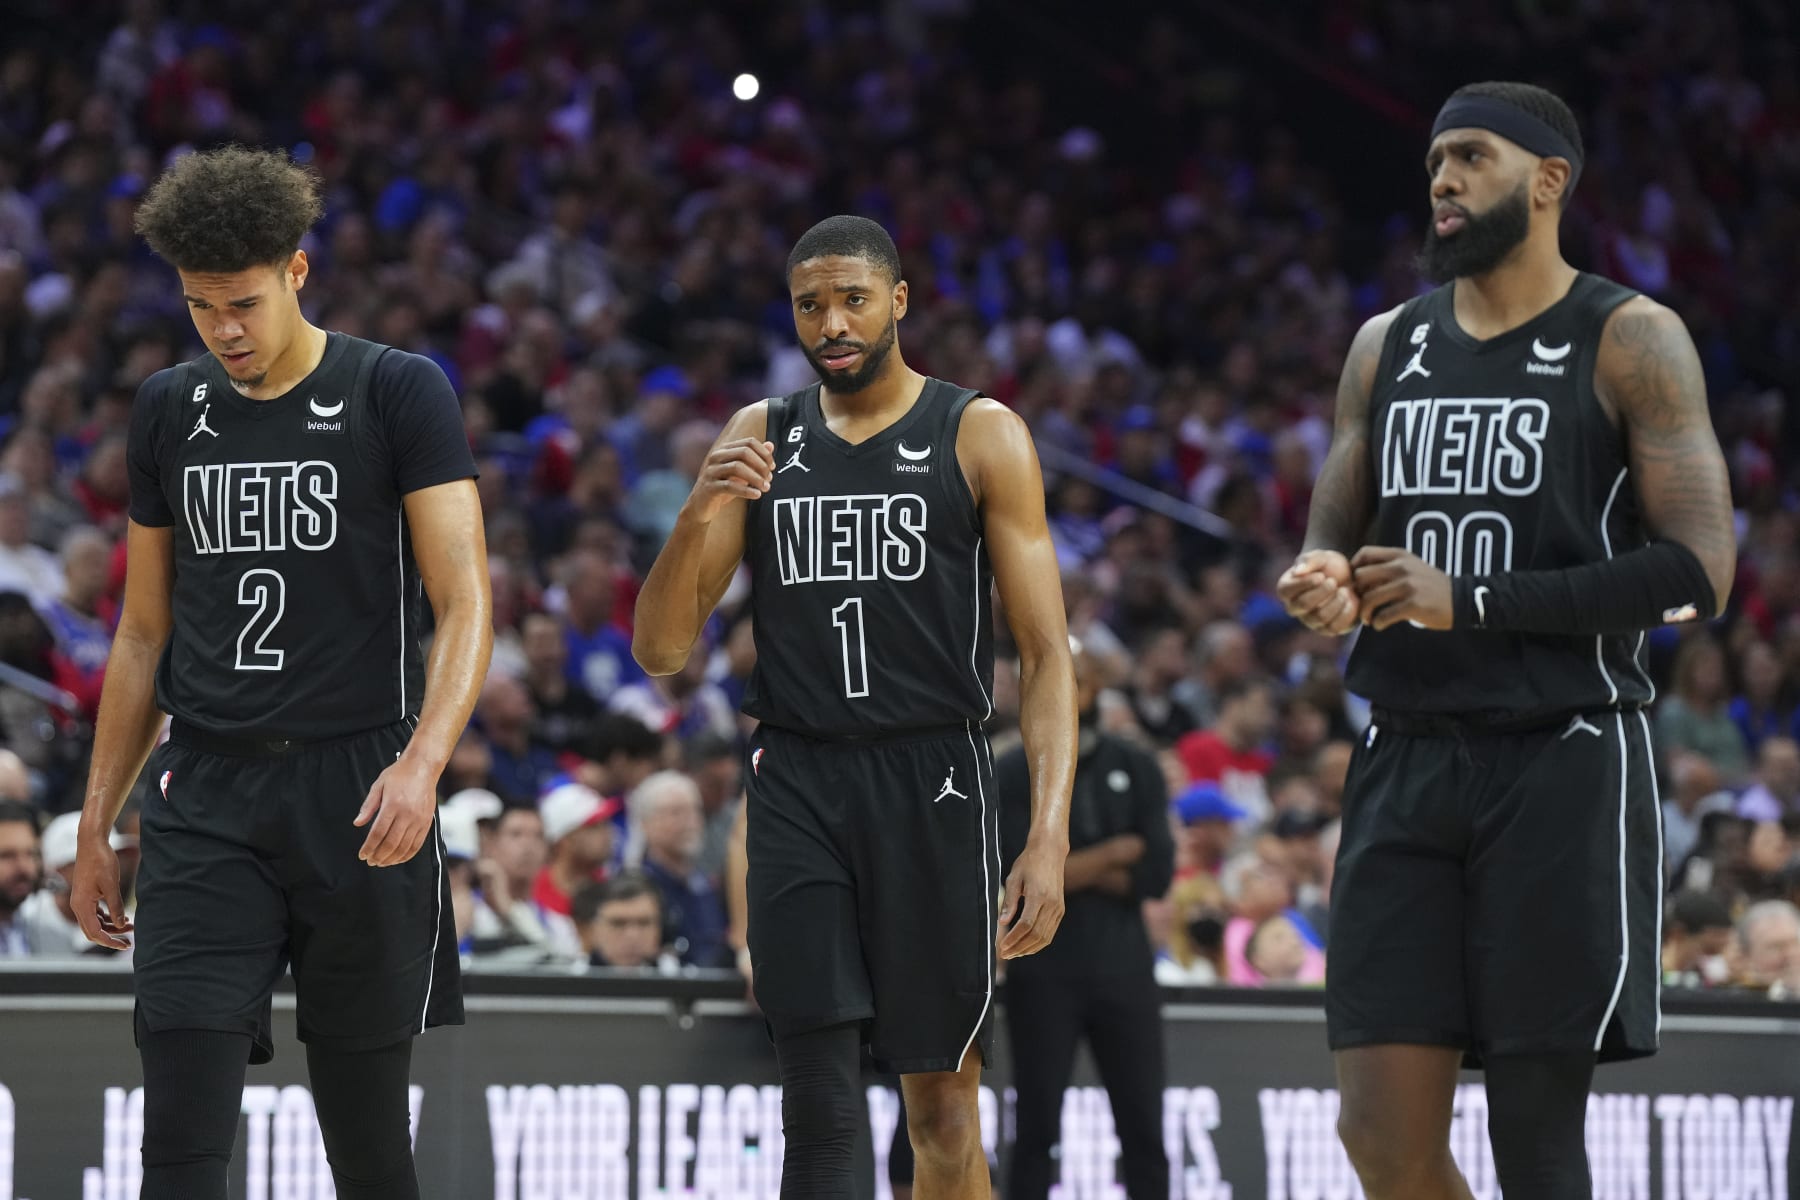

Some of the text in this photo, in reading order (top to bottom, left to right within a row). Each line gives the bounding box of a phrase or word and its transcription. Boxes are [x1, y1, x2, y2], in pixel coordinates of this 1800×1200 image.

[1409, 322, 1431, 346] 6
[1525, 360, 1565, 376] Webull
[192, 383, 208, 403] 6
[306, 420, 341, 432] Webull
[787, 425, 804, 443] 6
[896, 462, 930, 474] Webull
[1382, 397, 1551, 497] NETS
[184, 460, 338, 554] NETS
[772, 493, 928, 586] NETS
[234, 568, 286, 671] 2
[831, 597, 870, 699] 1
[486, 1083, 631, 1200] YOUR
[1258, 1087, 1367, 1200] YOU
[1654, 1093, 1795, 1200] TODAY
